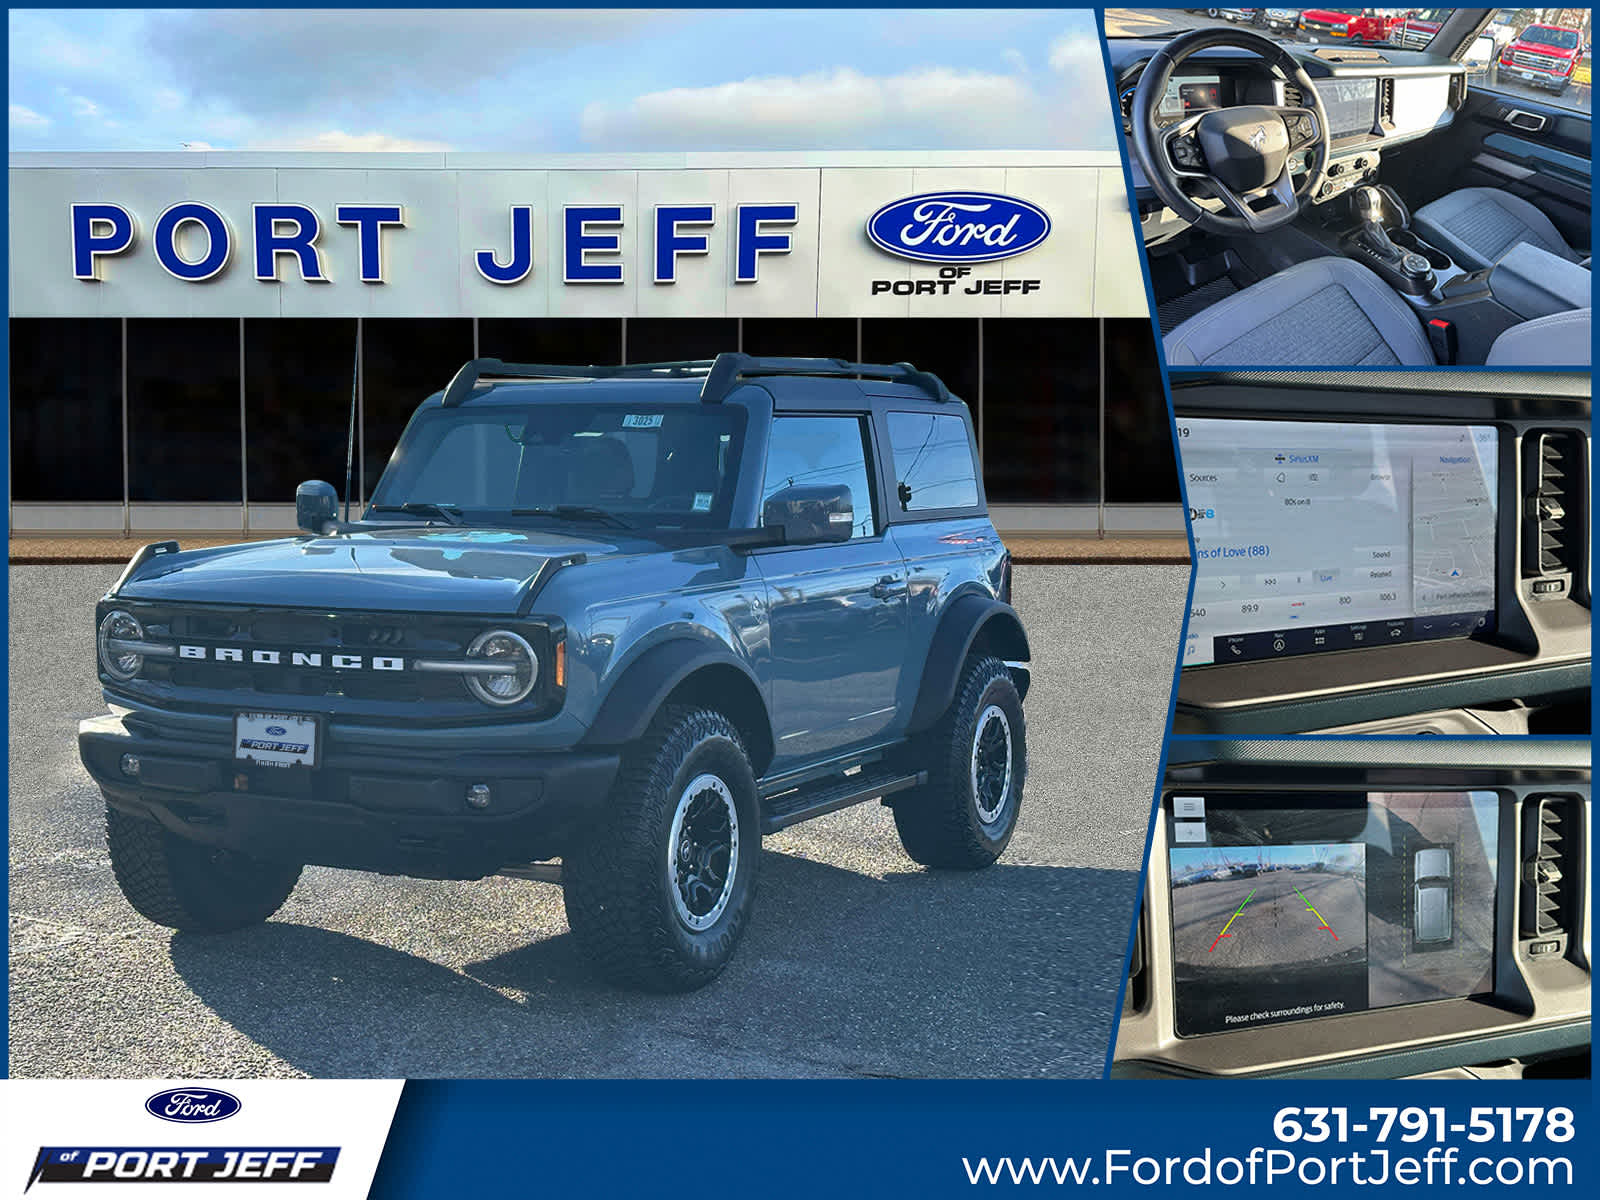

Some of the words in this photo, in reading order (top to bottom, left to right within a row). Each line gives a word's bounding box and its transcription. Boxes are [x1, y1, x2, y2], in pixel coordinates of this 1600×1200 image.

[900, 201, 1021, 246] Ford
[70, 202, 404, 283] PORT
[474, 202, 798, 284] JEFF
[938, 266, 971, 279] OF
[871, 280, 956, 296] PORT
[964, 280, 1041, 295] JEFF
[1289, 455, 1319, 463] SiriusXM
[1439, 456, 1471, 464] Navigation
[1189, 473, 1218, 482] Sources
[1210, 546, 1222, 558] of
[1223, 546, 1246, 557] Love
[1248, 545, 1270, 558] (88)
[1372, 551, 1391, 559] Sound
[1240, 604, 1259, 613] 89.9
[179, 645, 404, 671] BRONCO
[1225, 1014, 1249, 1024] Please
[1250, 1010, 1269, 1020] check
[1270, 1005, 1313, 1017] surroundings
[1314, 1003, 1323, 1012] for
